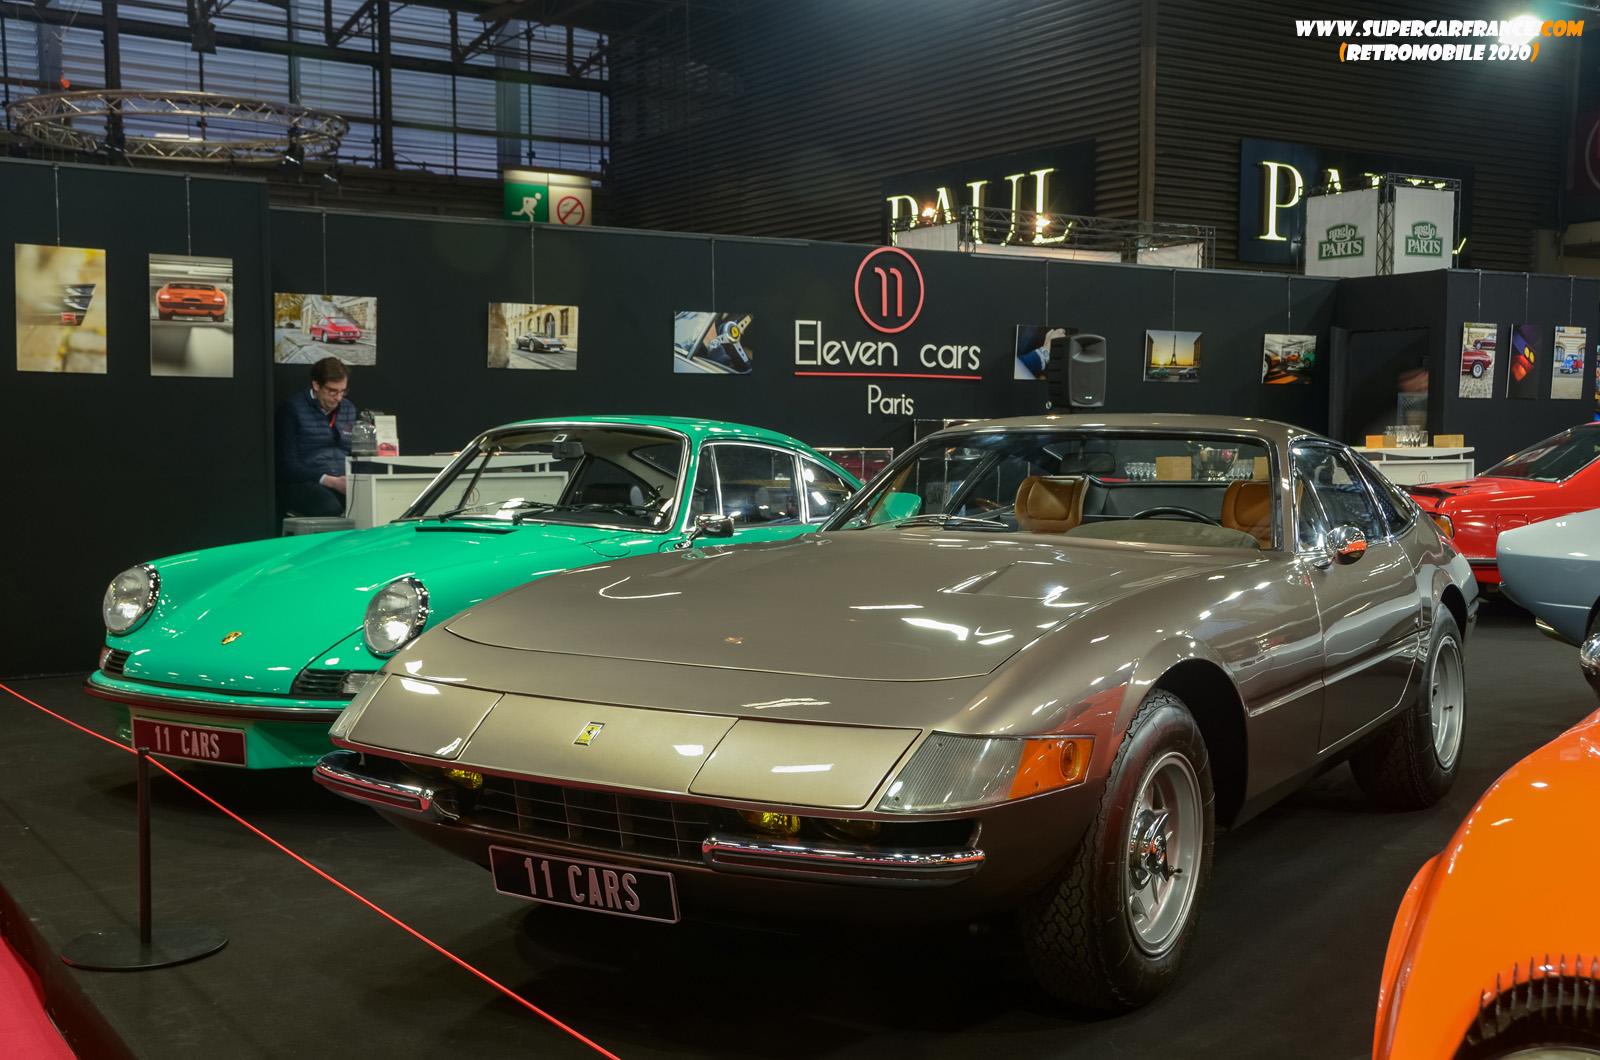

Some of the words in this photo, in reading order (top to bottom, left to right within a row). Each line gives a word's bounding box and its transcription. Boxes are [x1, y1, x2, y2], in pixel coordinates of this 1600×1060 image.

[1328, 225, 1355, 243] anglo
[1407, 239, 1441, 254] PARTS
[1414, 223, 1435, 240] anglo
[1321, 241, 1363, 257] PARTS
[874, 267, 903, 317] 11
[795, 320, 898, 366] Eleven
[919, 343, 981, 370] cars
[868, 384, 914, 415] Paris
[155, 725, 170, 752] 11
[180, 729, 220, 759] CARS
[524, 857, 553, 898] 11
[567, 865, 640, 911] CARS
